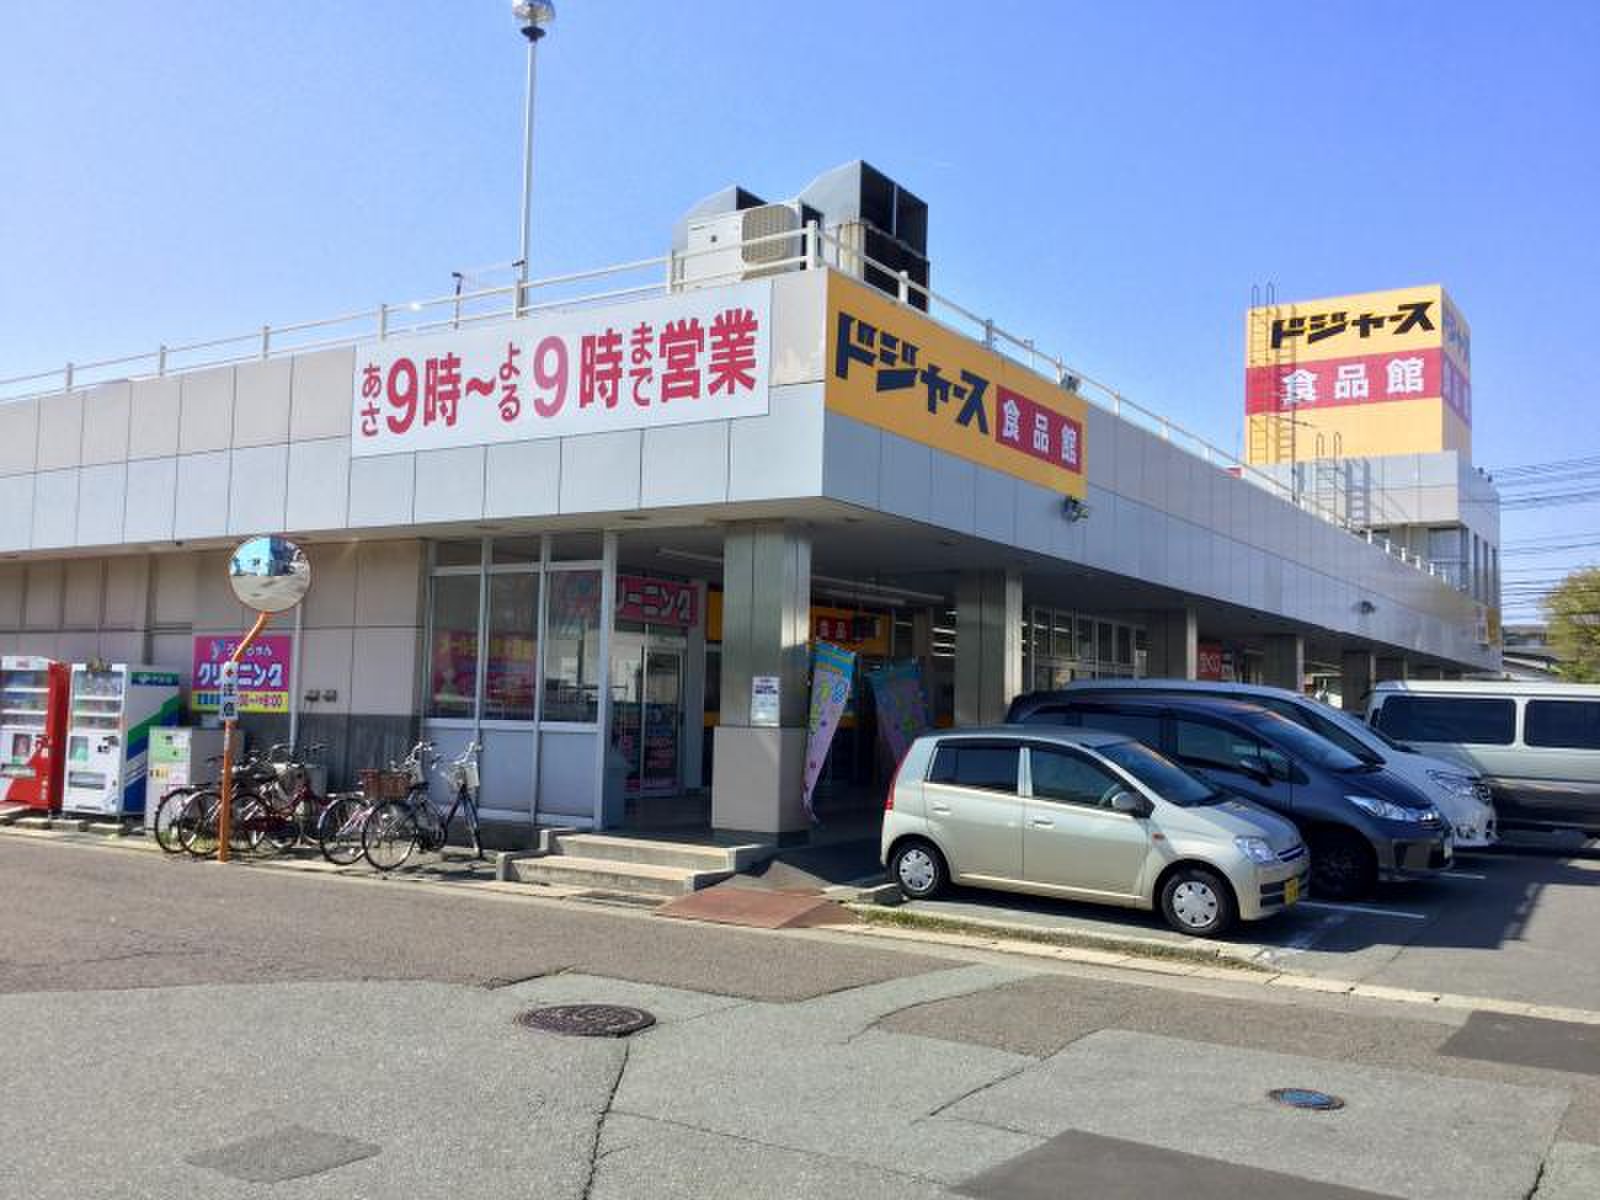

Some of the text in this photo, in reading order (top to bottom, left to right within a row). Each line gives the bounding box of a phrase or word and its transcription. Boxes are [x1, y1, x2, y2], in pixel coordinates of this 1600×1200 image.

[1271, 302, 1435, 349] ドジャース
[835, 311, 990, 435] ドジャース
[1281, 357, 1425, 406] 食品館
[1002, 399, 1077, 466] 食品館
